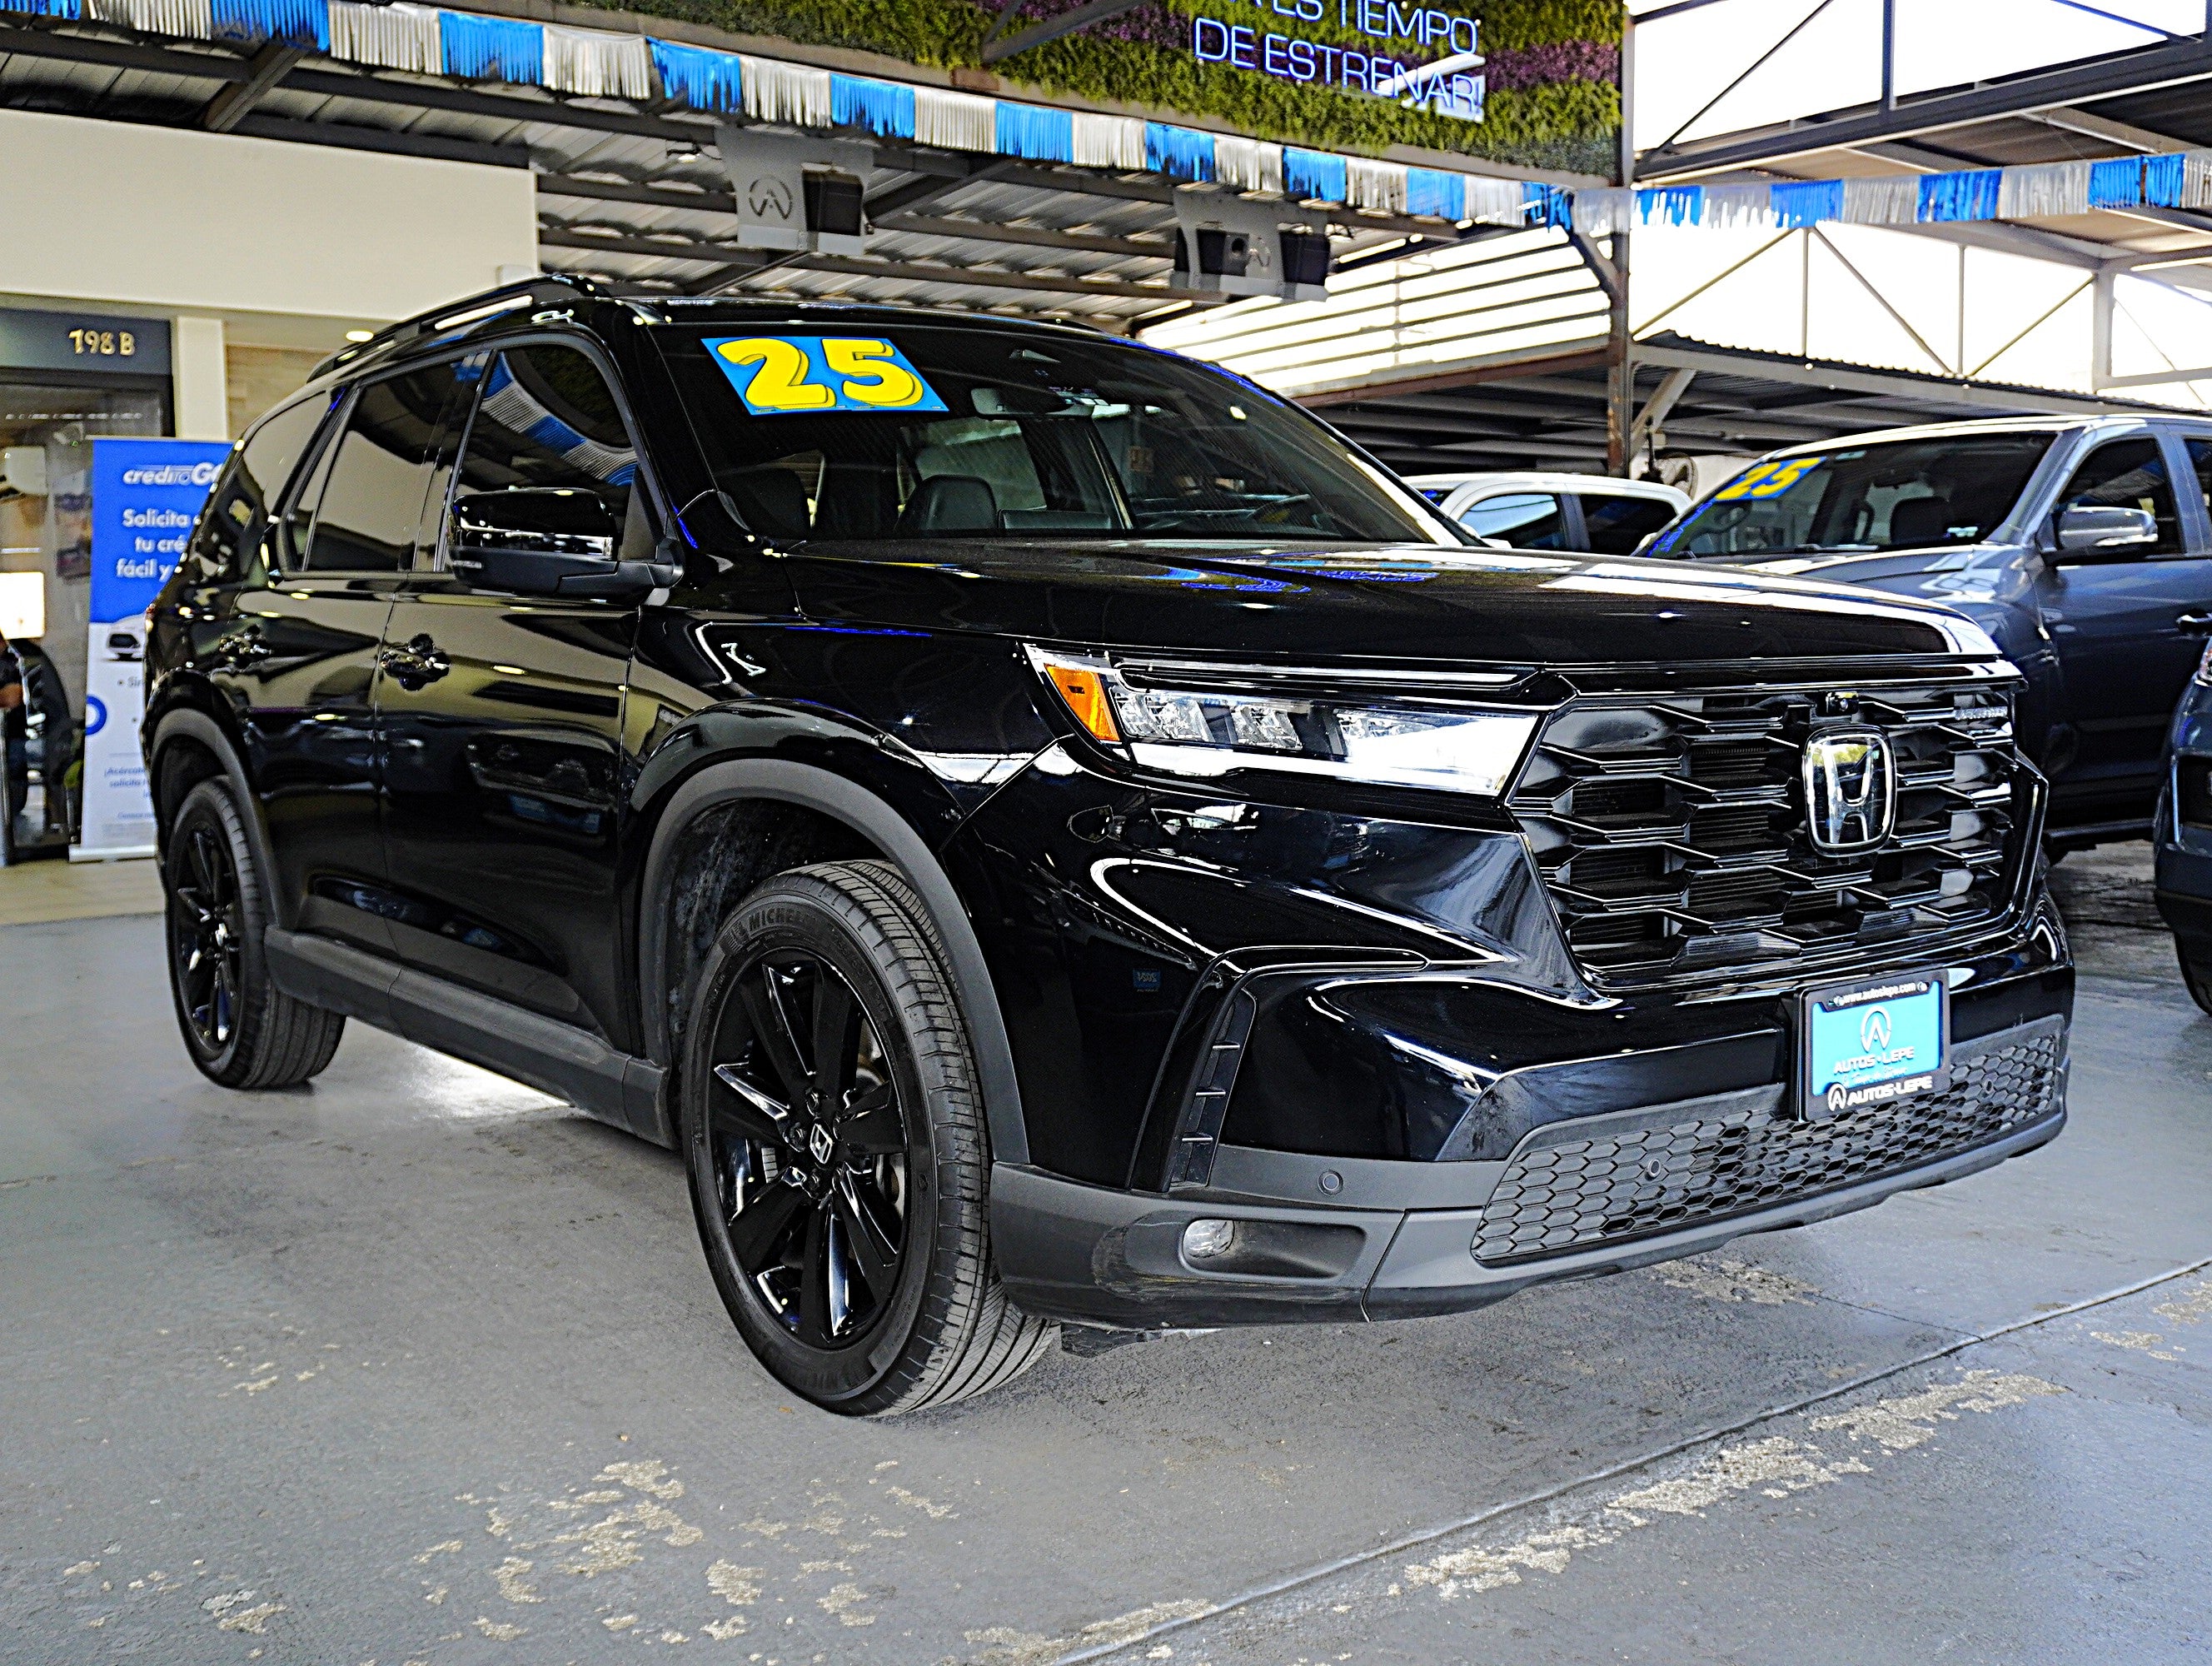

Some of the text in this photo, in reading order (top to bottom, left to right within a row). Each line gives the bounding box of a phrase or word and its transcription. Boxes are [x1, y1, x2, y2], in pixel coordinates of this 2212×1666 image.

[1194, 17, 1485, 115] DE ESTRENAR!
[68, 328, 135, 357] 198 B
[717, 337, 924, 410] 25
[1715, 457, 1821, 500] 25
[122, 508, 189, 527] Solicita
[135, 536, 155, 553] tu
[117, 557, 174, 583] fácil y
